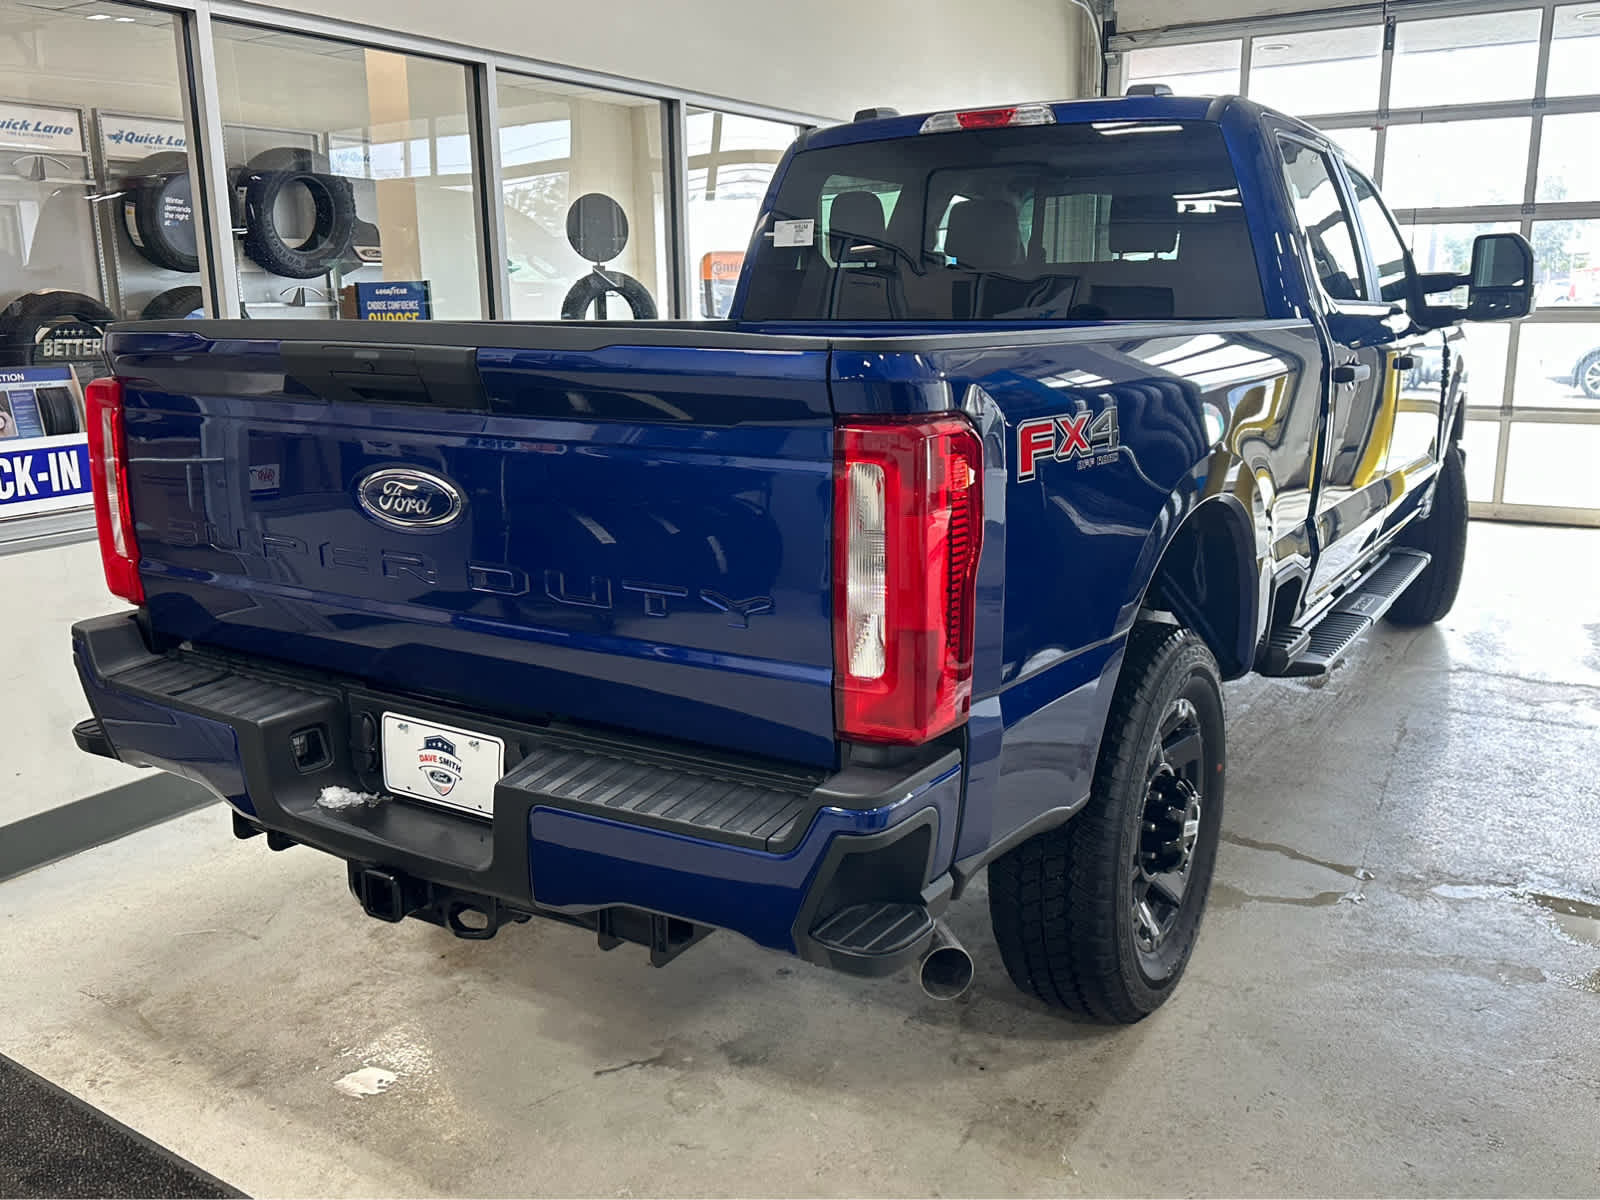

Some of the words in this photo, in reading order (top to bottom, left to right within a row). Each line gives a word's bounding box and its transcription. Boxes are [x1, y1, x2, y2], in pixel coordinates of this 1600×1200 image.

[33, 121, 74, 135] Lane
[125, 131, 164, 145] Quick
[164, 205, 191, 213] demands
[43, 338, 102, 356] BETTER
[1017, 406, 1120, 484] FX4
[0, 450, 82, 500] CK-IN
[379, 480, 433, 515] Ford
[166, 515, 439, 586] SUPER
[465, 559, 776, 630] DUTY
[419, 754, 437, 762] DAVE
[439, 757, 461, 773] SMITH
